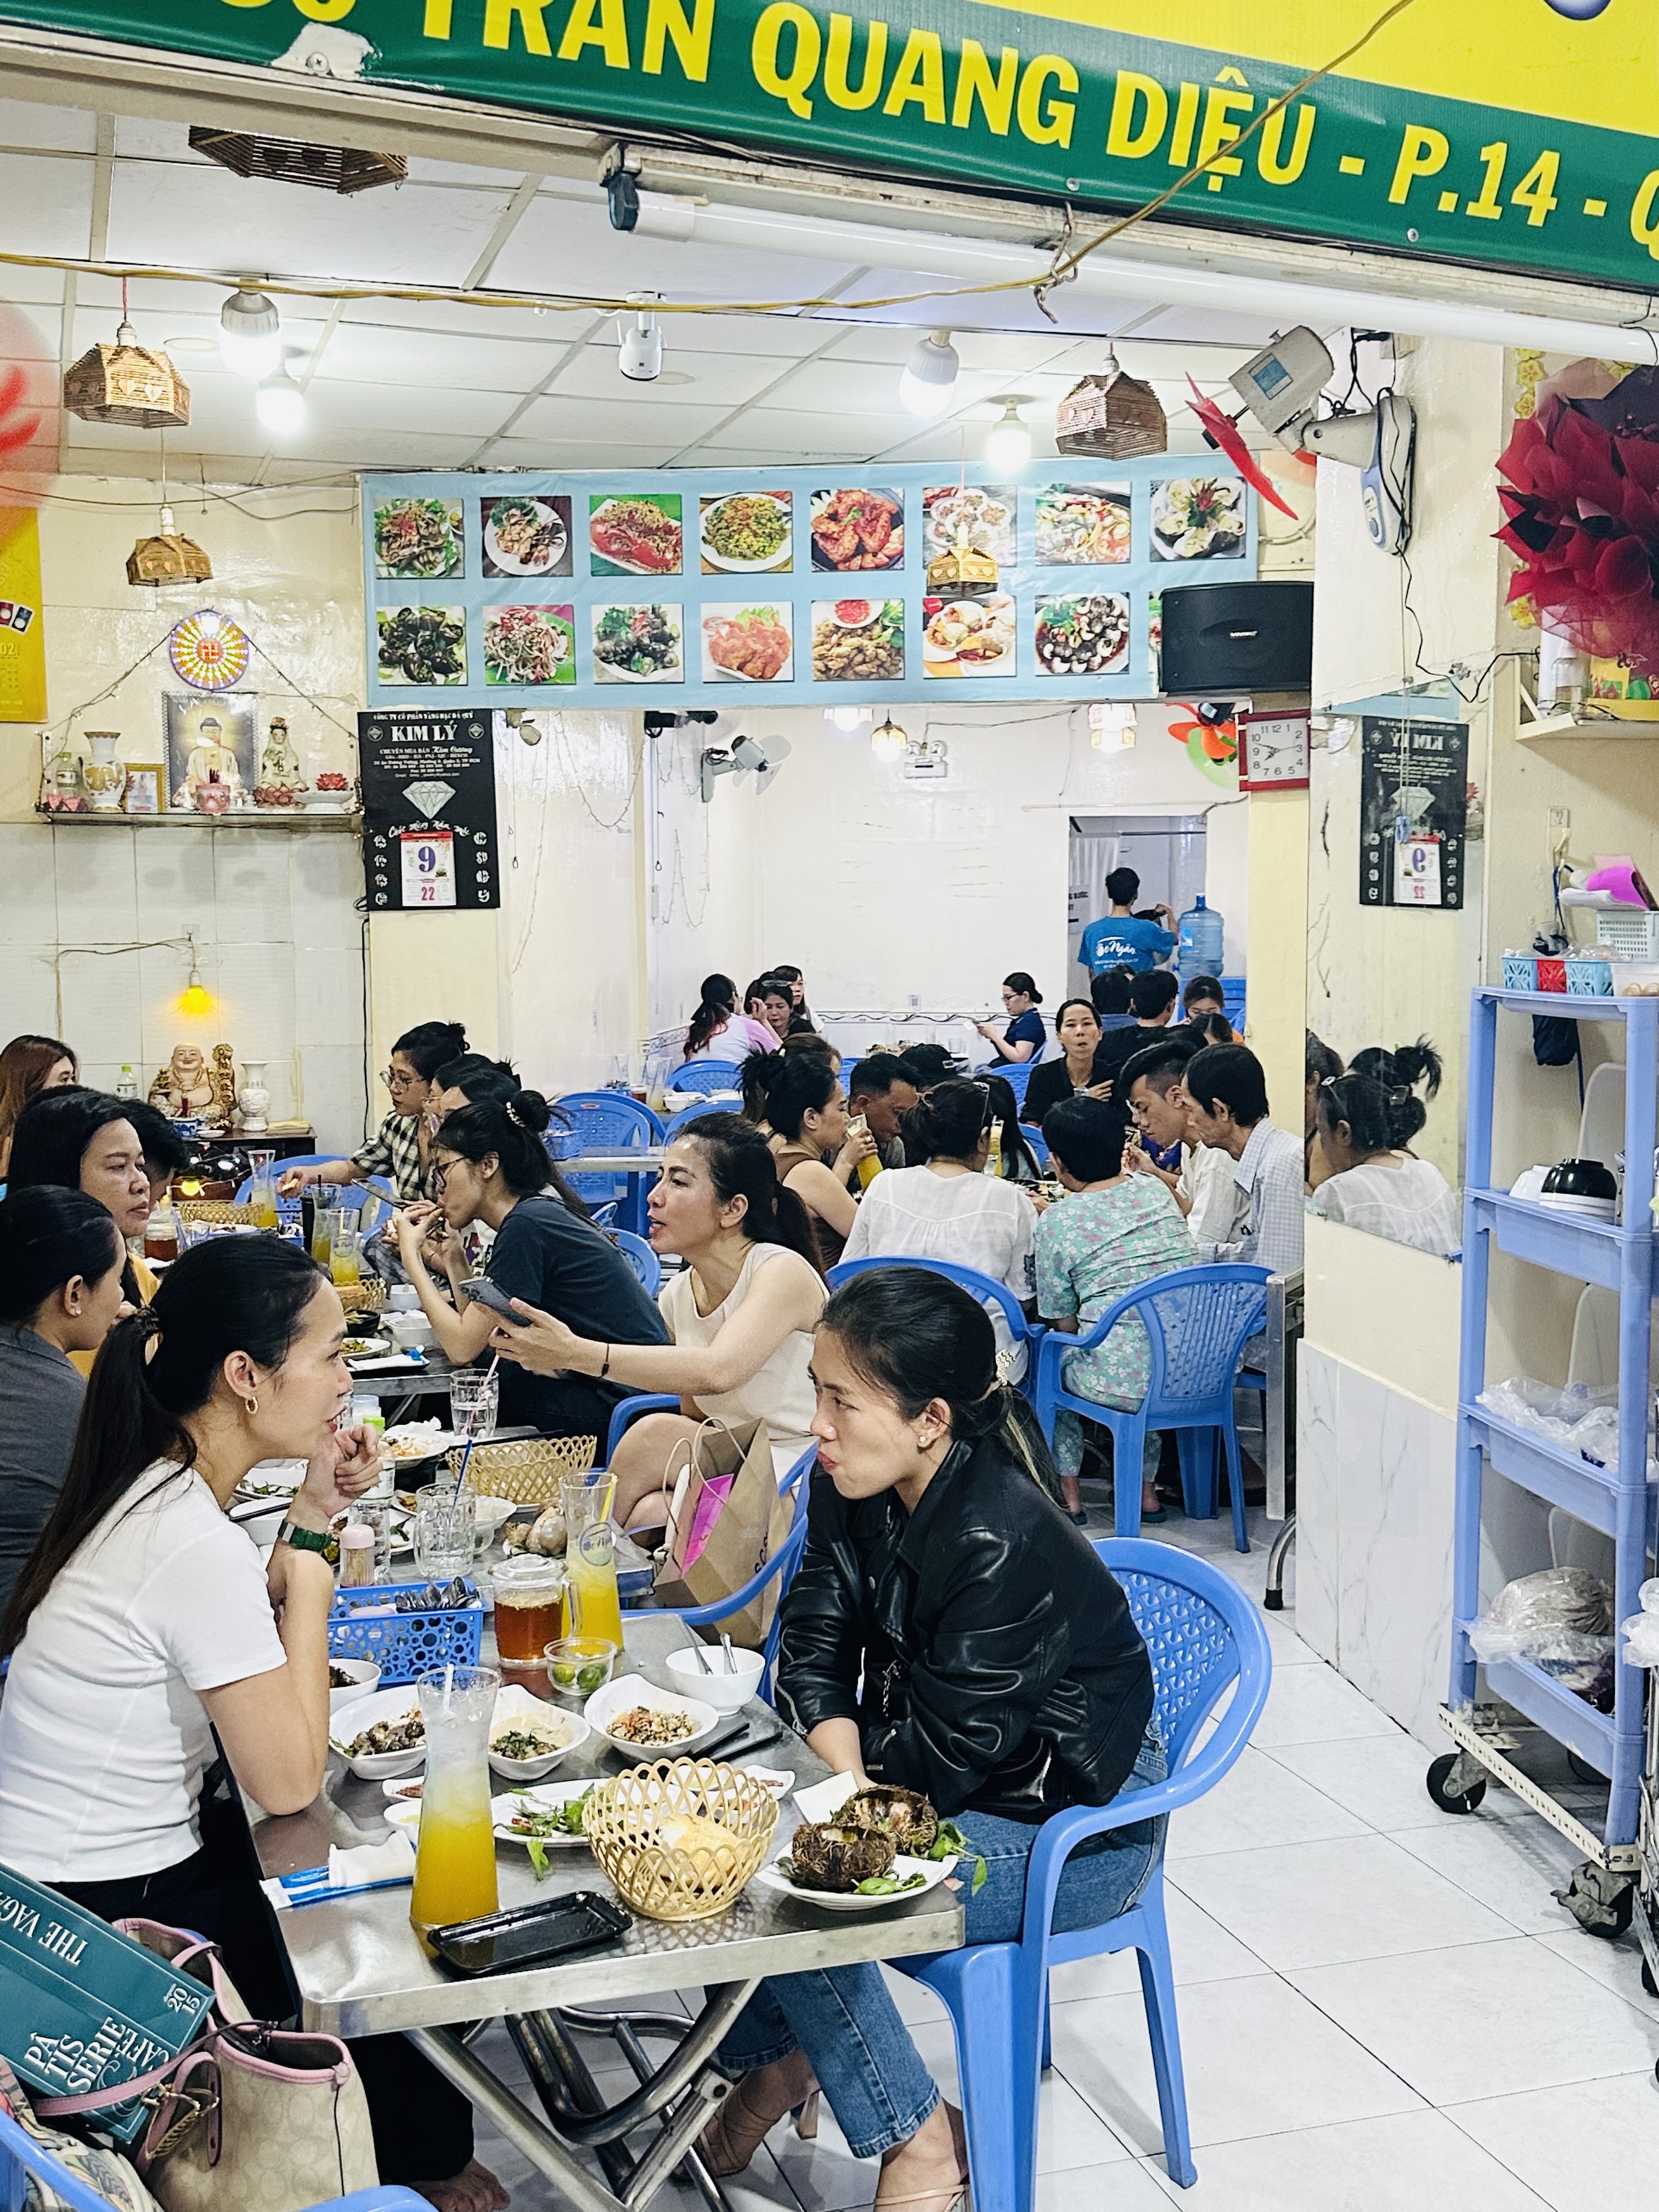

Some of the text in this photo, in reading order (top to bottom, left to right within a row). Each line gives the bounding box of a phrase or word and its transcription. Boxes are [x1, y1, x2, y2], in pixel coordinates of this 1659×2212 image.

[751, 1, 1080, 150] QUANG
[1105, 66, 1316, 193] DIỆU
[1339, 155, 1365, 176] -
[1388, 123, 1561, 227] P.14
[1583, 198, 1608, 217] -
[391, 720, 458, 742] KIM LÝ
[1272, 724, 1282, 733] 12
[1295, 730, 1302, 739] 2
[1251, 733, 1261, 742] 10
[1252, 747, 1260, 756] 9
[1253, 761, 1260, 769] 8
[1263, 768, 1269, 776] 7
[1274, 767, 1282, 775] 6
[1288, 766, 1295, 775] 5
[418, 846, 436, 872] 9
[421, 887, 435, 901] 22
[38, 1921, 88, 1966] THE
[167, 1987, 188, 2013] 20
[182, 1995, 201, 2015] 15
[24, 2032, 60, 2070] PÂ
[44, 2034, 84, 2079] TIS
[67, 2016, 127, 2094] SERIE
